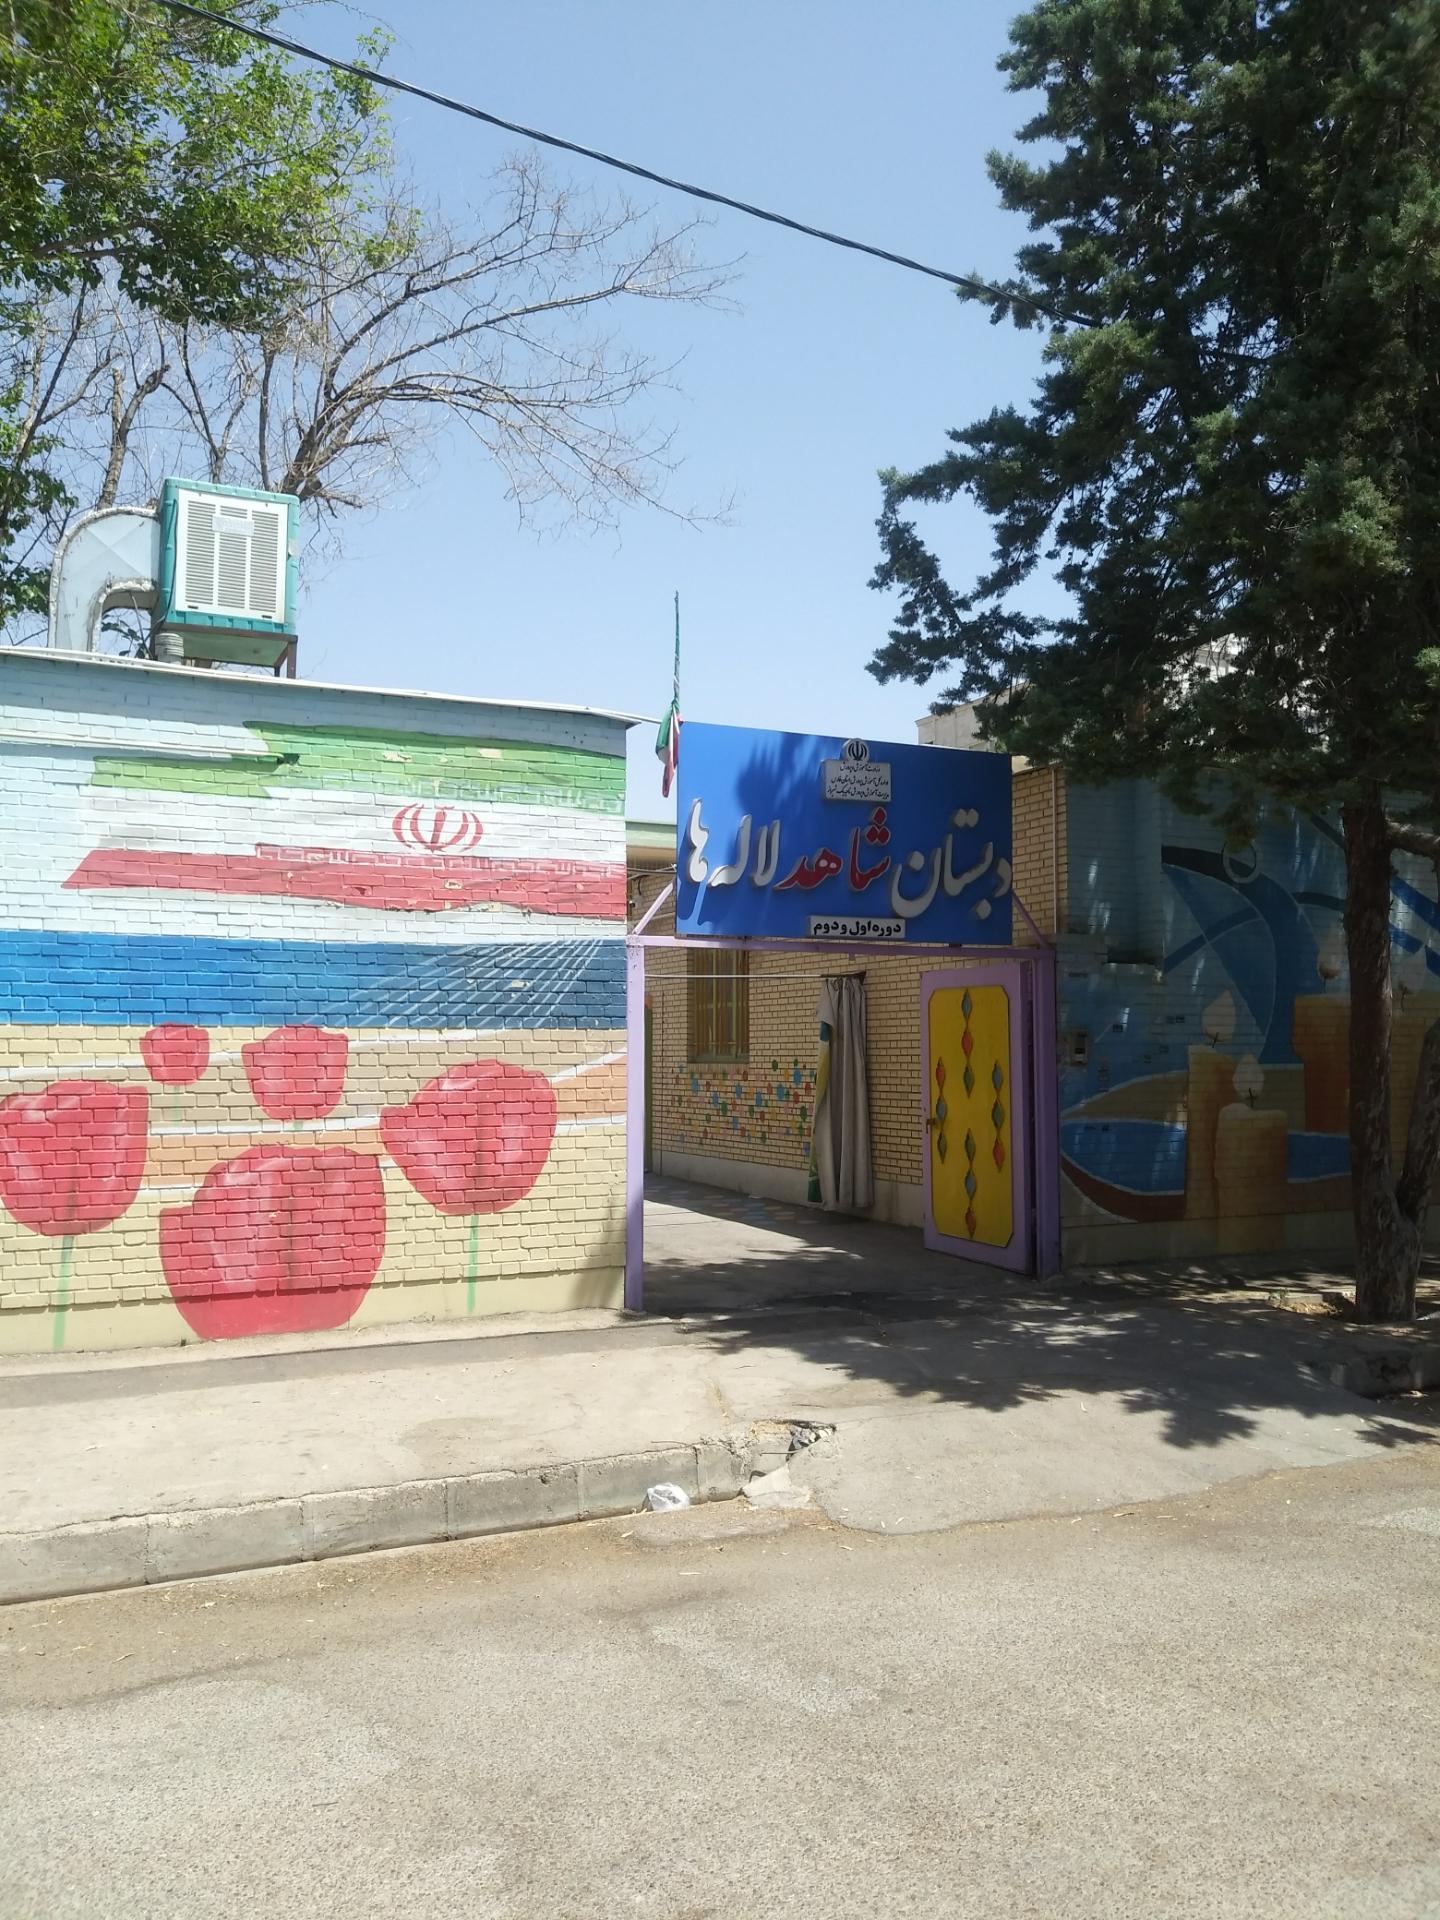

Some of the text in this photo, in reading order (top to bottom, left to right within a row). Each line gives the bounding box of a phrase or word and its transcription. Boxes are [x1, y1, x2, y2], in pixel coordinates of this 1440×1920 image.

[774, 805, 892, 892] شاهد
[891, 808, 1013, 919] دبستان
[813, 920, 902, 937] دوره اول و دوم
